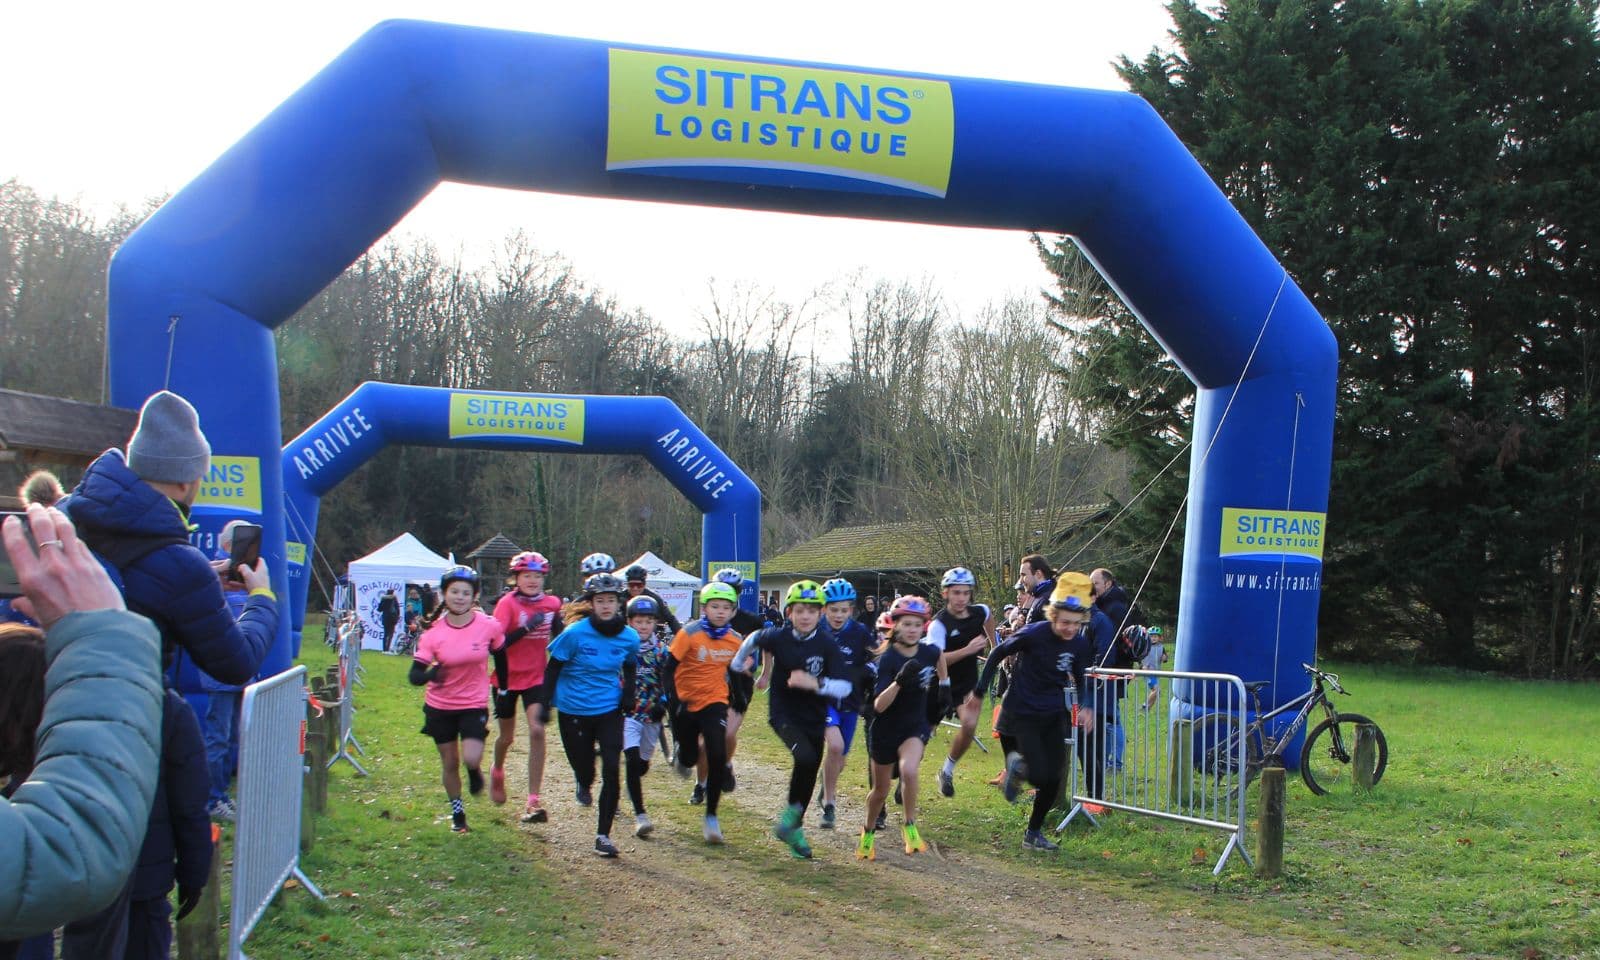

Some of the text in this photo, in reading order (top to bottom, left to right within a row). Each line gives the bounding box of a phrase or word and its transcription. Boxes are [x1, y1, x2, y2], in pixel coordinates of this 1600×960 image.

[655, 113, 907, 156] LOGISTIQUE
[467, 398, 568, 419] SITRANS
[467, 417, 566, 431] LOGISTIQUE
[293, 407, 372, 479] ARRIVEE
[657, 428, 734, 499] ARRIVEE
[1237, 515, 1320, 537] SITRANS
[1236, 535, 1318, 548] LOGISTIQUE
